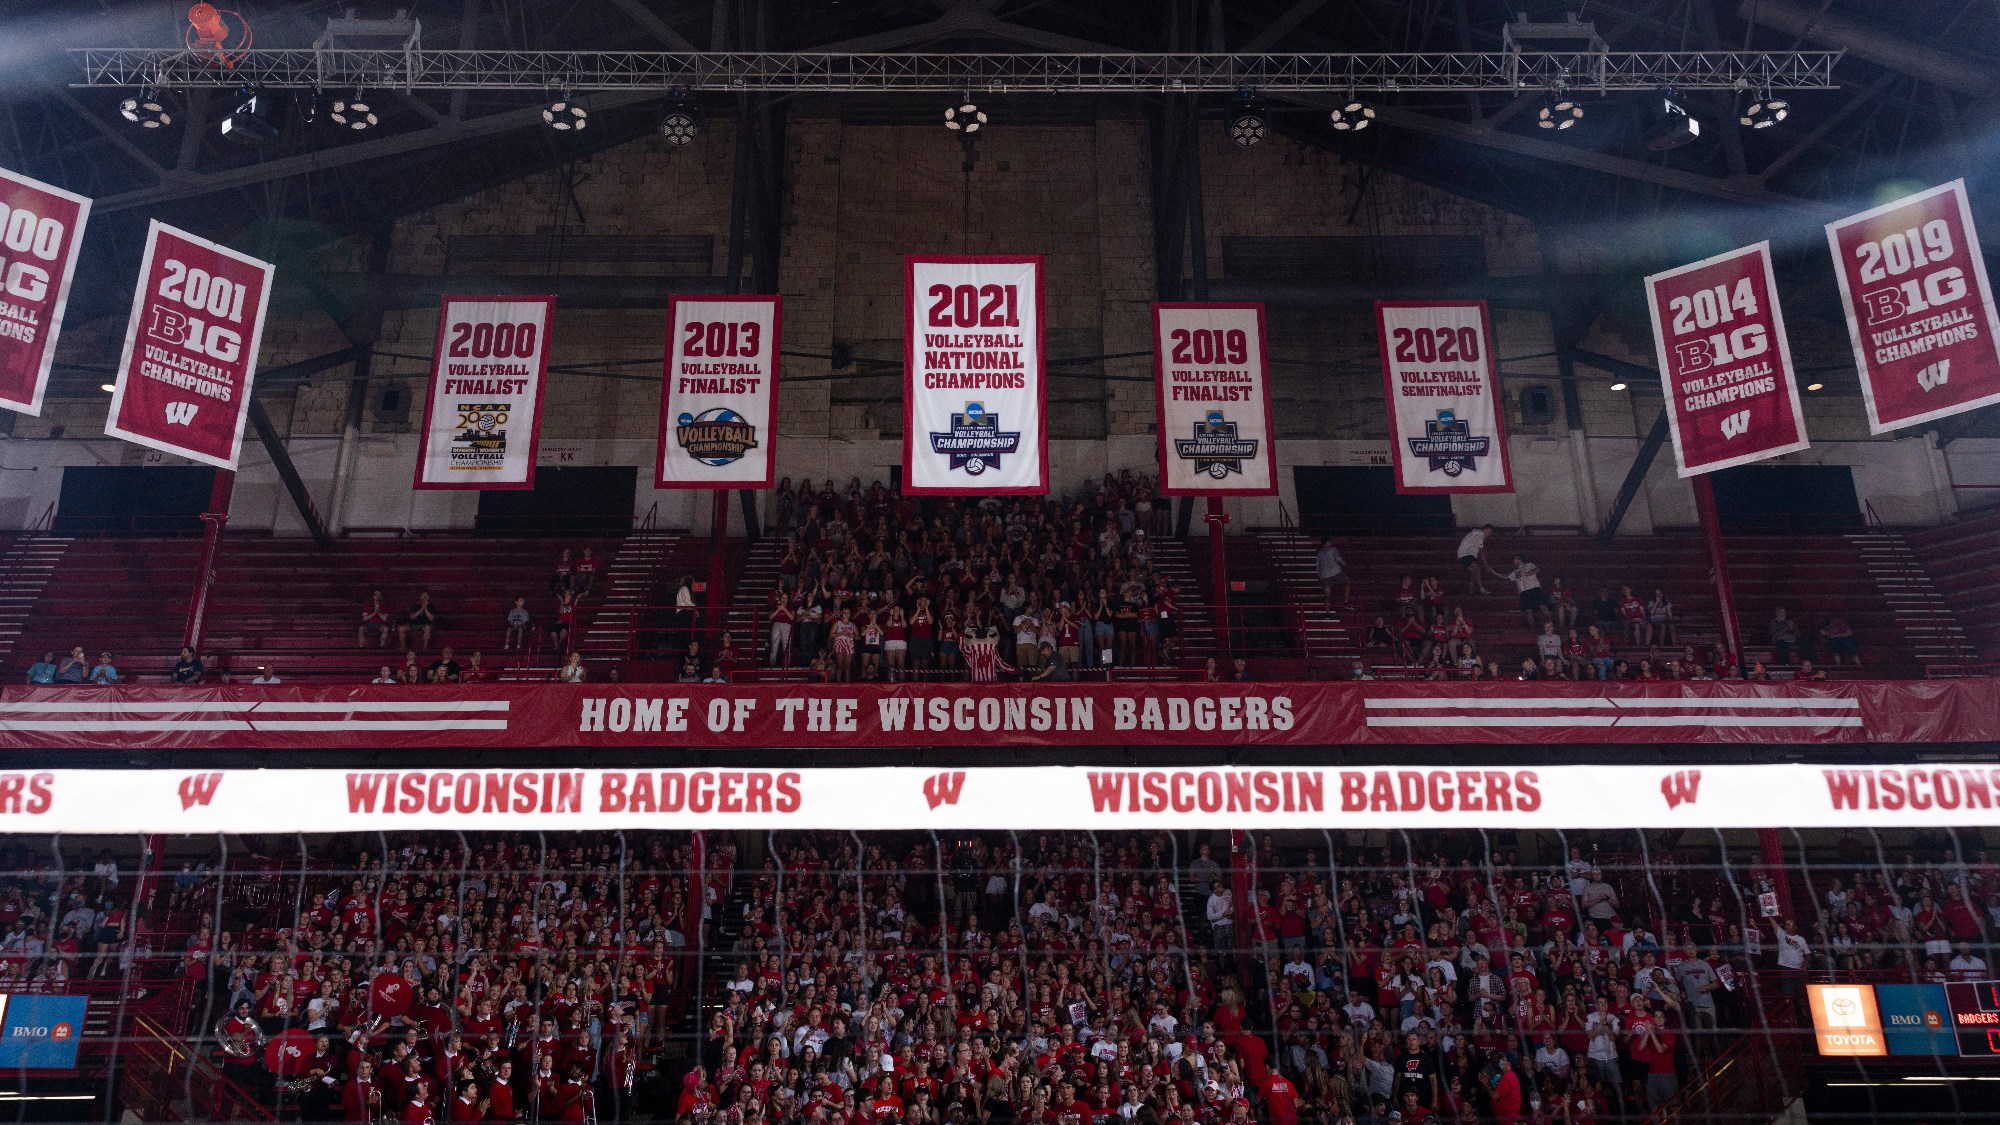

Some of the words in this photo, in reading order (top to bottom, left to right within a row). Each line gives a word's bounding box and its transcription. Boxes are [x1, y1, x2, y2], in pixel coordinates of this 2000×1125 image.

[1856, 218, 1954, 284] 2019
[159, 258, 246, 323] 2001
[928, 283, 1019, 328] 2021
[1670, 276, 1758, 336] 2014
[1871, 307, 1973, 347] VOLLEYBALL
[448, 322, 537, 358] 2000
[683, 321, 761, 358] 2013
[924, 333, 1024, 349] VOLLEYBALL
[1171, 328, 1248, 365] 2019
[1393, 326, 1480, 363] 2020
[1875, 322, 1978, 365] CHAMPIONS
[145, 344, 234, 385] VOLLEYBALL
[680, 362, 761, 375] VOLLEYBALL
[924, 351, 1025, 370] NATIONAL
[448, 363, 529, 377] VOLLEYBALL
[1172, 370, 1252, 383] VOLLEYBALL
[1400, 370, 1480, 383] VOLLEYBALL
[1682, 361, 1773, 395] VOLLEYBALL
[140, 360, 232, 402] CHAMPIONS
[444, 379, 528, 395] FINALIST
[679, 377, 761, 394] FINALIST
[924, 372, 1025, 389] CHAMPIONS
[1172, 385, 1252, 402] FINALIST
[1402, 385, 1482, 397] SEMIFINALIST
[1684, 376, 1776, 412] CHAMPIONS
[679, 426, 754, 446] VOLLEYBALL
[937, 438, 1014, 448] CHAMPIONSHIP
[688, 442, 744, 452] CHAMPIONSHIP
[1183, 444, 1253, 454] CHAMPIONSHIP
[1416, 441, 1485, 452] CHAMPIONSHIP
[561, 453, 573, 461] KK
[580, 697, 690, 732] HOME
[707, 698, 757, 732] OF
[776, 698, 858, 732] THE
[877, 697, 1094, 732] WISCONSIN
[1113, 696, 1294, 731] BADGERS
[345, 772, 585, 814] WISCONSIN
[600, 772, 802, 813] BADGERS
[1086, 771, 1324, 813] WISCONSIN
[1339, 771, 1542, 812] BADGERS
[1891, 1015, 1921, 1025] BMO
[1958, 1012, 1999, 1024] BADGERS
[13, 1026, 48, 1037] BMO
[1825, 1035, 1876, 1045] TOYOTA
